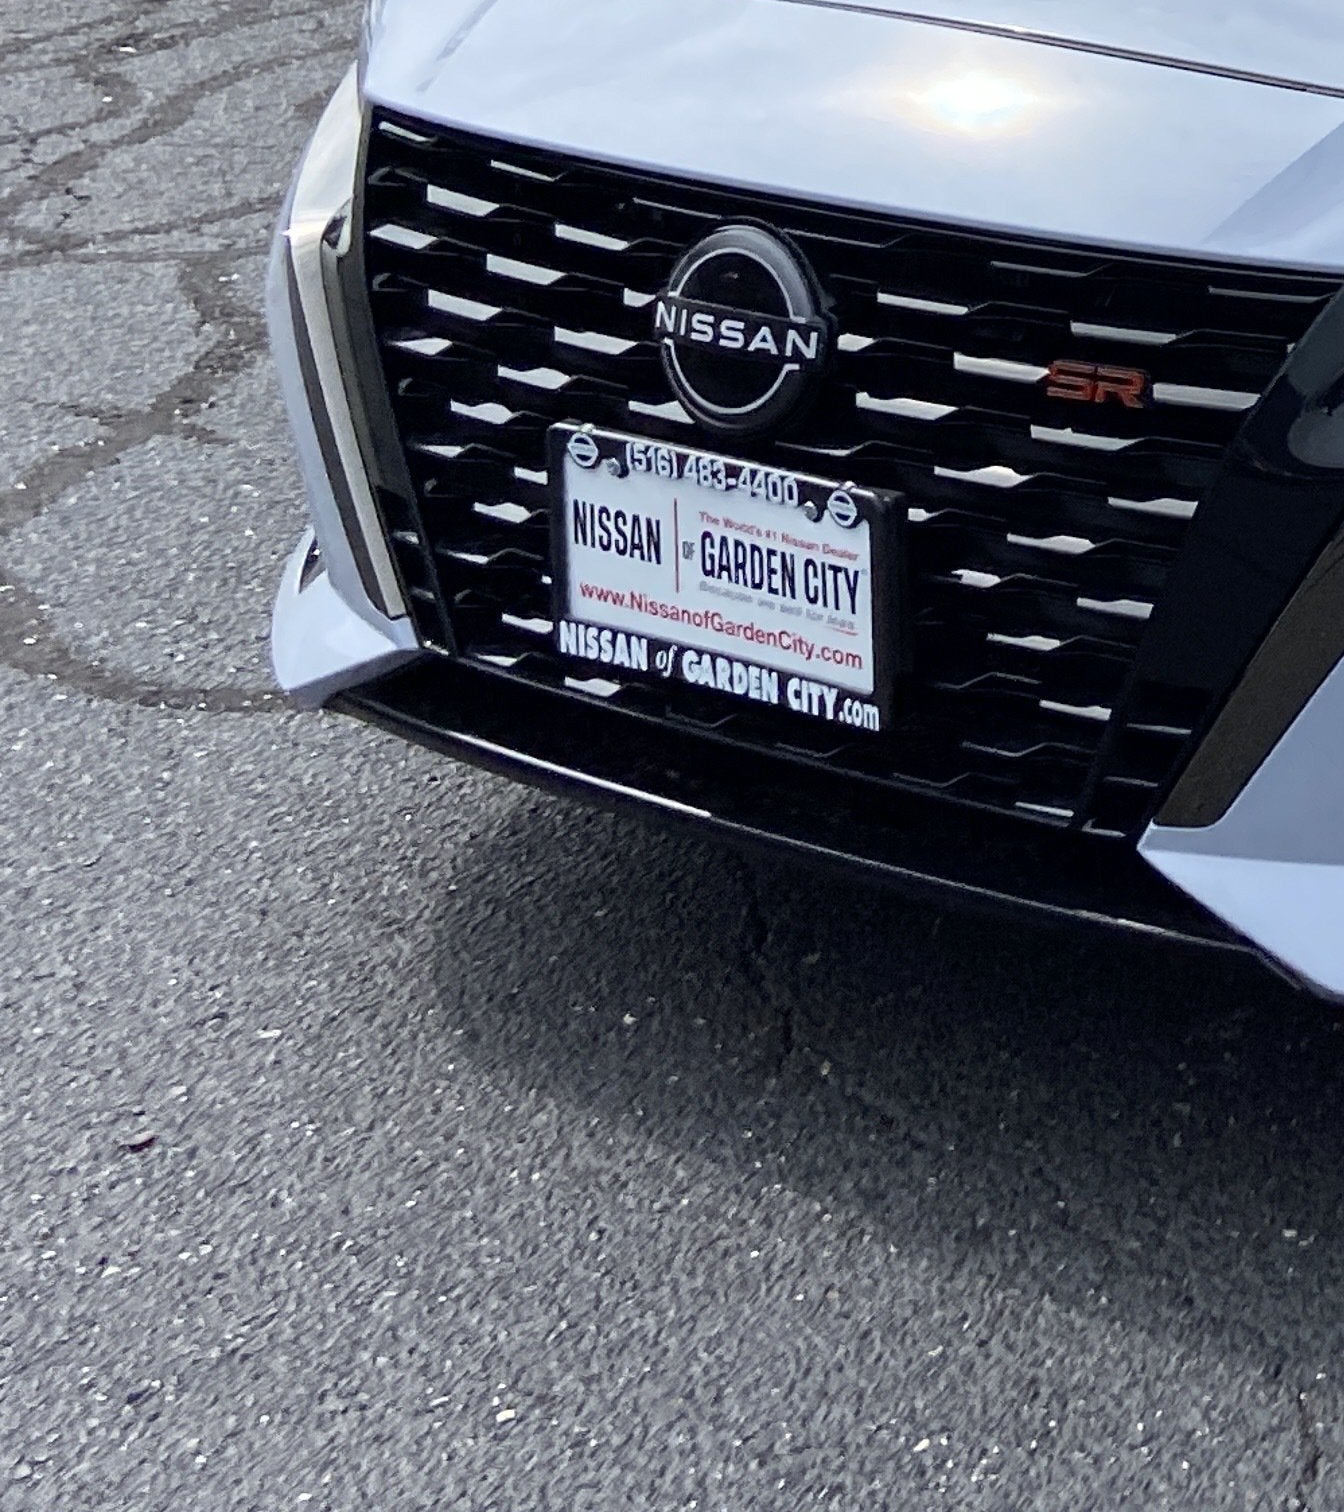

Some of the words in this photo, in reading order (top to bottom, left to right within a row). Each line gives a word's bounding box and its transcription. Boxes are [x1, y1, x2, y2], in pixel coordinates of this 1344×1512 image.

[655, 300, 819, 359] NISSAN
[1046, 359, 1145, 408] SR
[625, 442, 678, 479] (516)
[684, 454, 798, 507] 483-4400
[573, 498, 662, 565] NISSAN
[682, 540, 695, 561] OF
[701, 530, 796, 600] GARDEN
[804, 558, 859, 615] CITY
[559, 620, 648, 671] NISSAN
[655, 645, 677, 678] of
[682, 649, 779, 704] GARDEN
[579, 582, 863, 670] www.NissanofGardenCity.com
